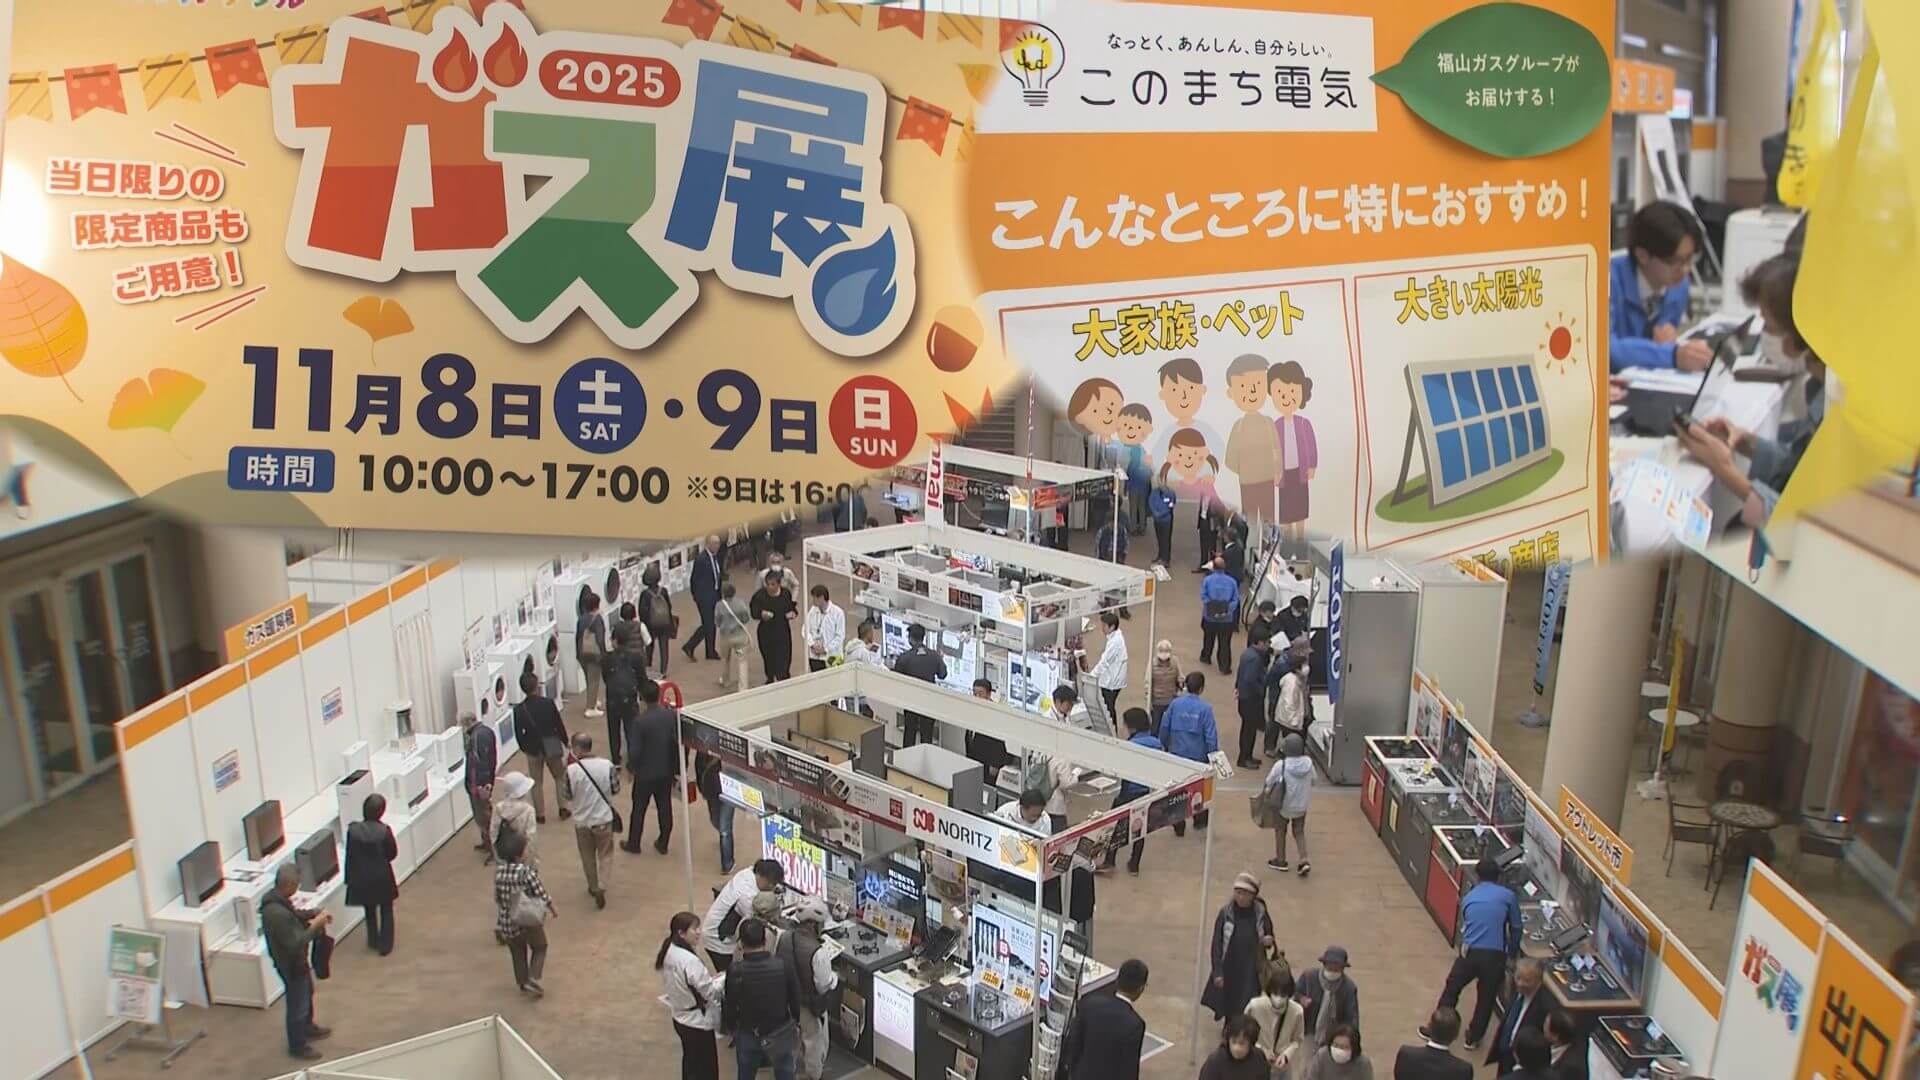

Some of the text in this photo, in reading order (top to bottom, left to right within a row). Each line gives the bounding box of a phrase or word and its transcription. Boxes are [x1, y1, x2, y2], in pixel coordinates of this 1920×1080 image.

[1107, 32, 1334, 59] なっとく、あんしん、自分らしい。
[1437, 51, 1580, 76] 福山ガスグループが
[555, 58, 666, 100] 2025
[1080, 64, 1359, 110] このまち電気
[49, 160, 221, 198] 当日限りの
[74, 208, 247, 246] 限定商品も
[991, 177, 1590, 252] こんなところに特におすすめ！
[115, 250, 241, 301] ご用意！
[1395, 266, 1545, 326] 大きい太陽光
[1073, 292, 1304, 361] 大家族・ペット
[579, 420, 621, 443] SAT
[850, 435, 898, 458] SUN
[246, 453, 315, 488] 時間
[938, 818, 994, 852] NORITZ
[1566, 801, 1623, 869] アウトレット市
[1820, 984, 1890, 1080] 出口
